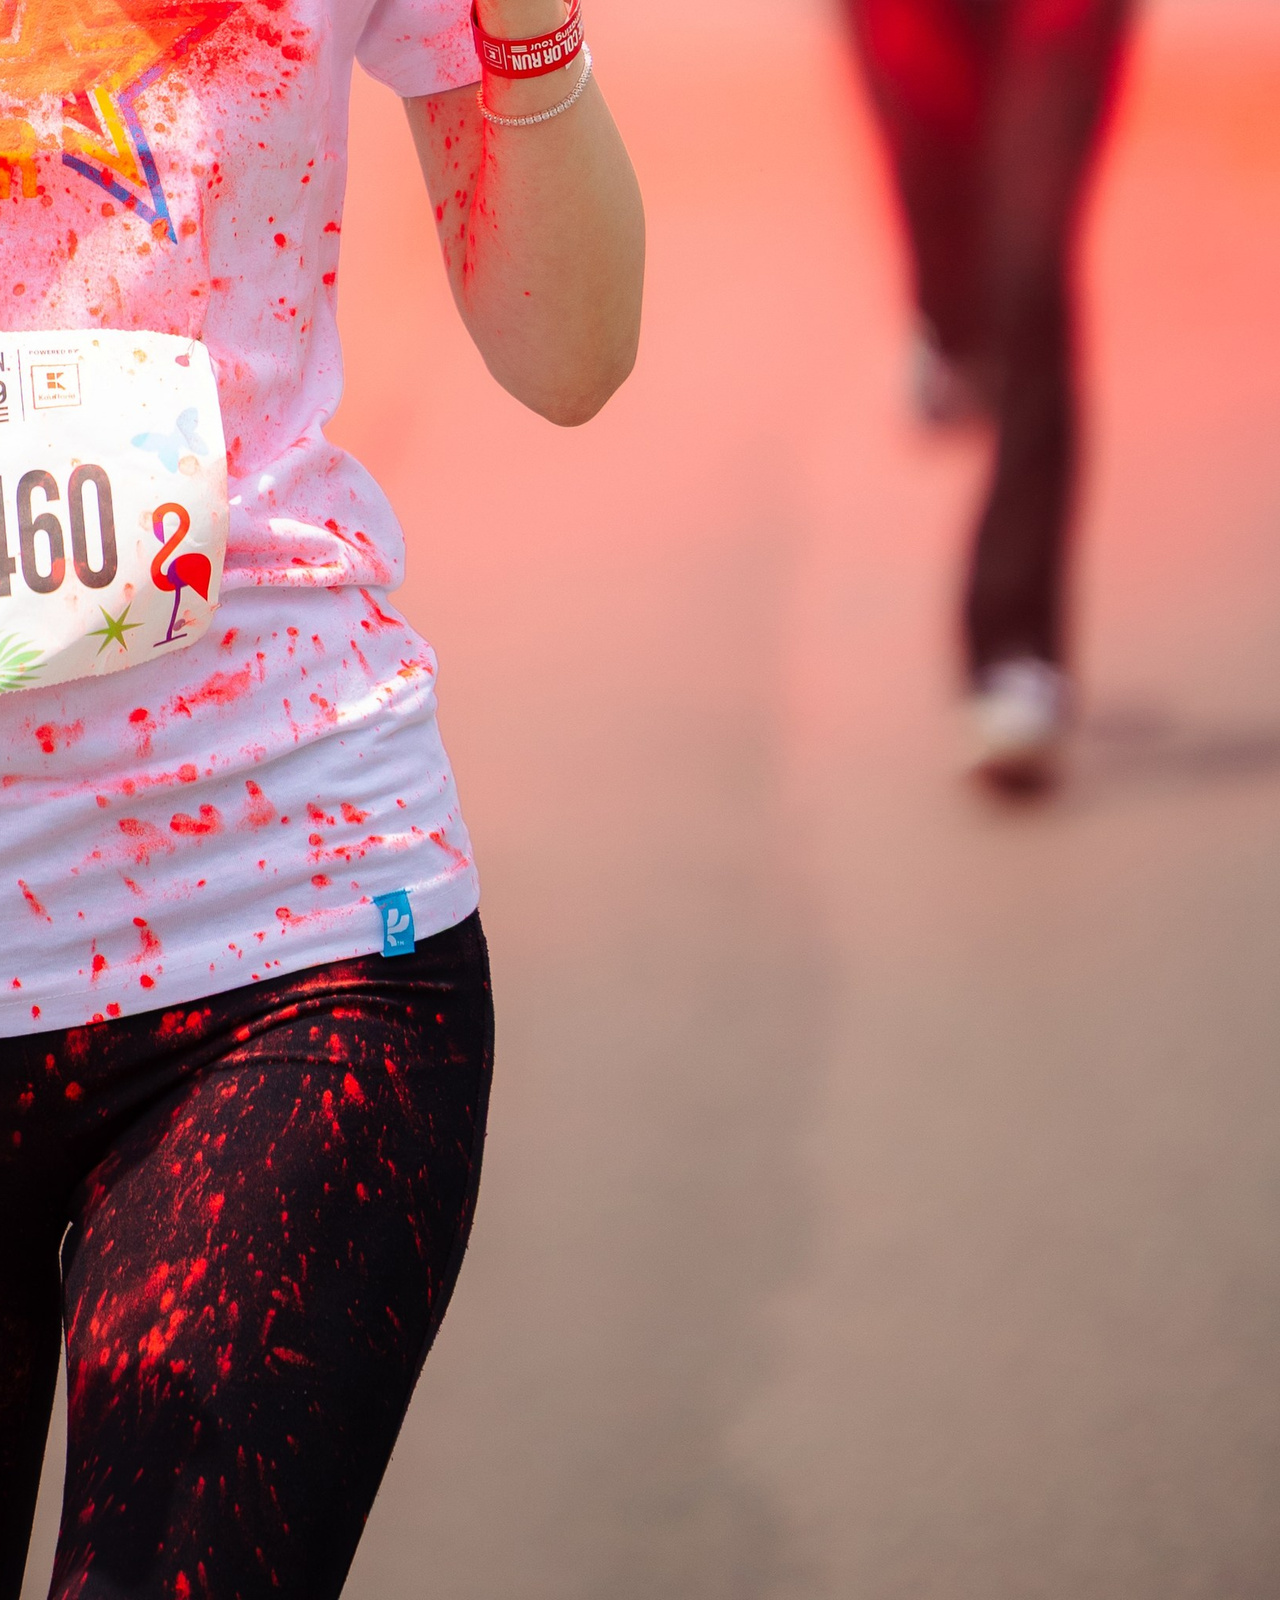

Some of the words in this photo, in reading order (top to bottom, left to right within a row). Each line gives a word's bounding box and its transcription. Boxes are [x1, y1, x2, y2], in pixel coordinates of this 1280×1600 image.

[530, 39, 554, 51] tour
[543, 29, 579, 65] COLOR
[511, 52, 542, 71] RUN
